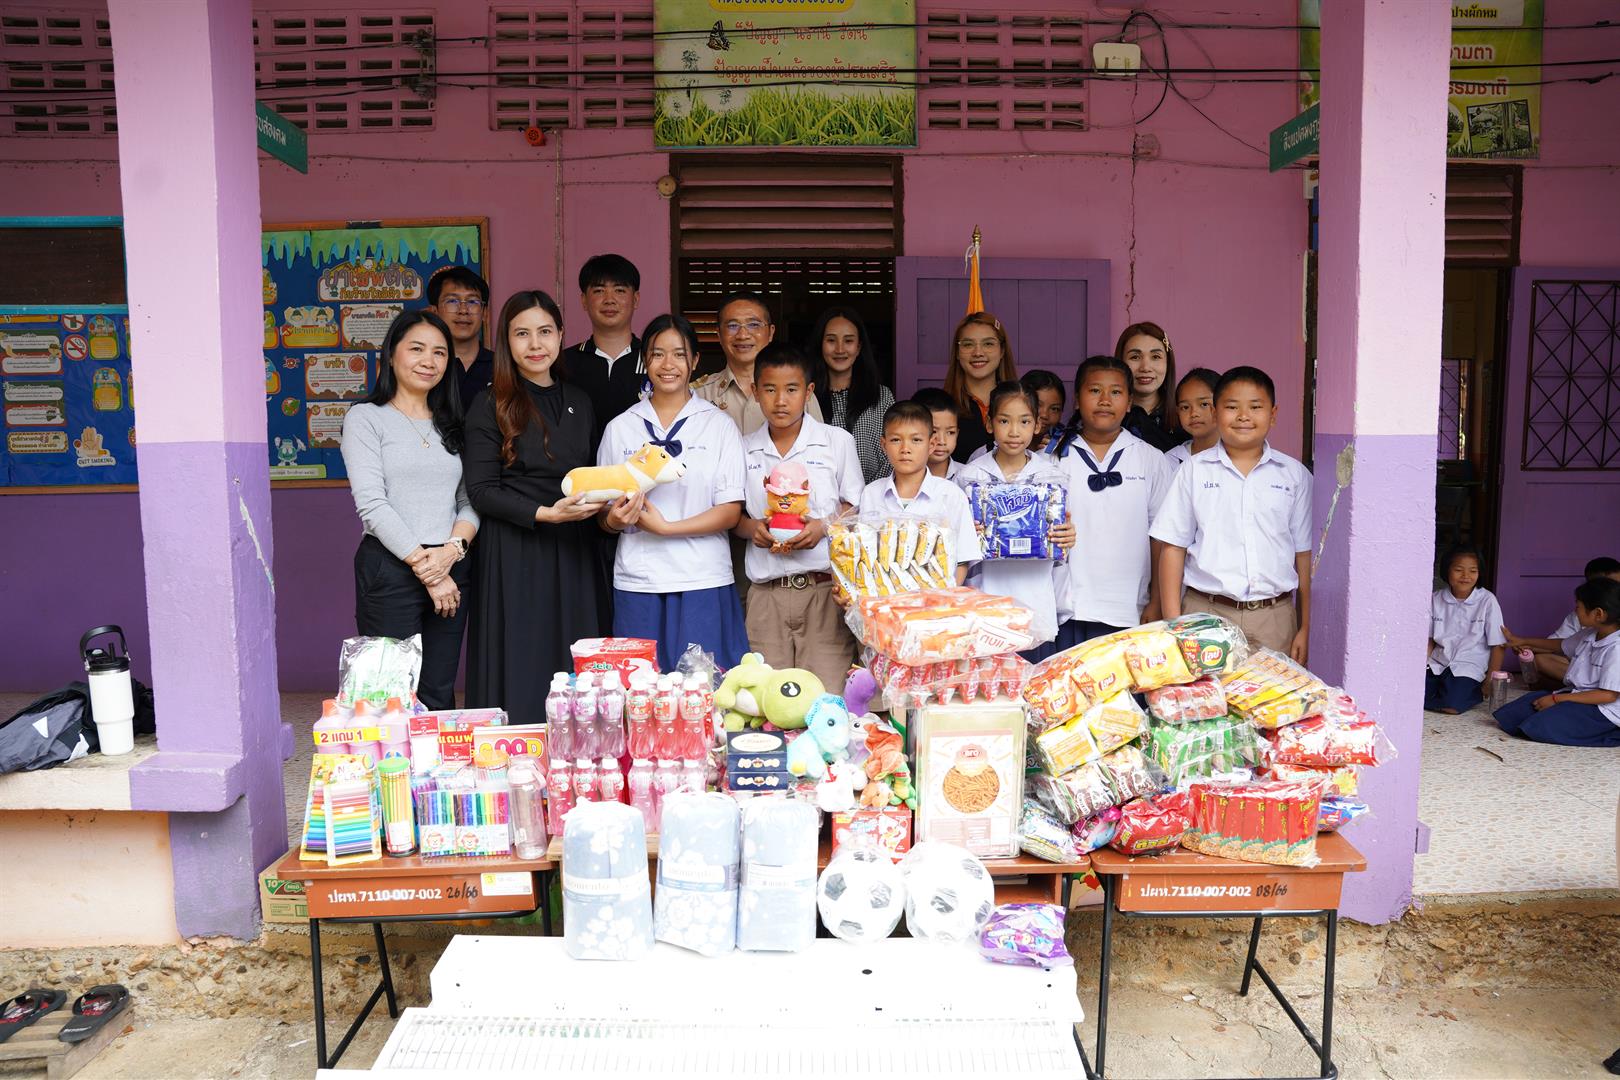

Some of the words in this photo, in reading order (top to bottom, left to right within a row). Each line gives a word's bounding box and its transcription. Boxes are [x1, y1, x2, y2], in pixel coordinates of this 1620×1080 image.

[323, 263, 417, 287] ยาเสพติด
[321, 732, 329, 743] 2
[331, 731, 354, 743] แถม
[356, 729, 363, 741] 1
[438, 733, 473, 745] แถมฟ
[328, 888, 443, 904] ปผห.7110-007-002
[1139, 883, 1252, 898] ปผห.7110-007-002
